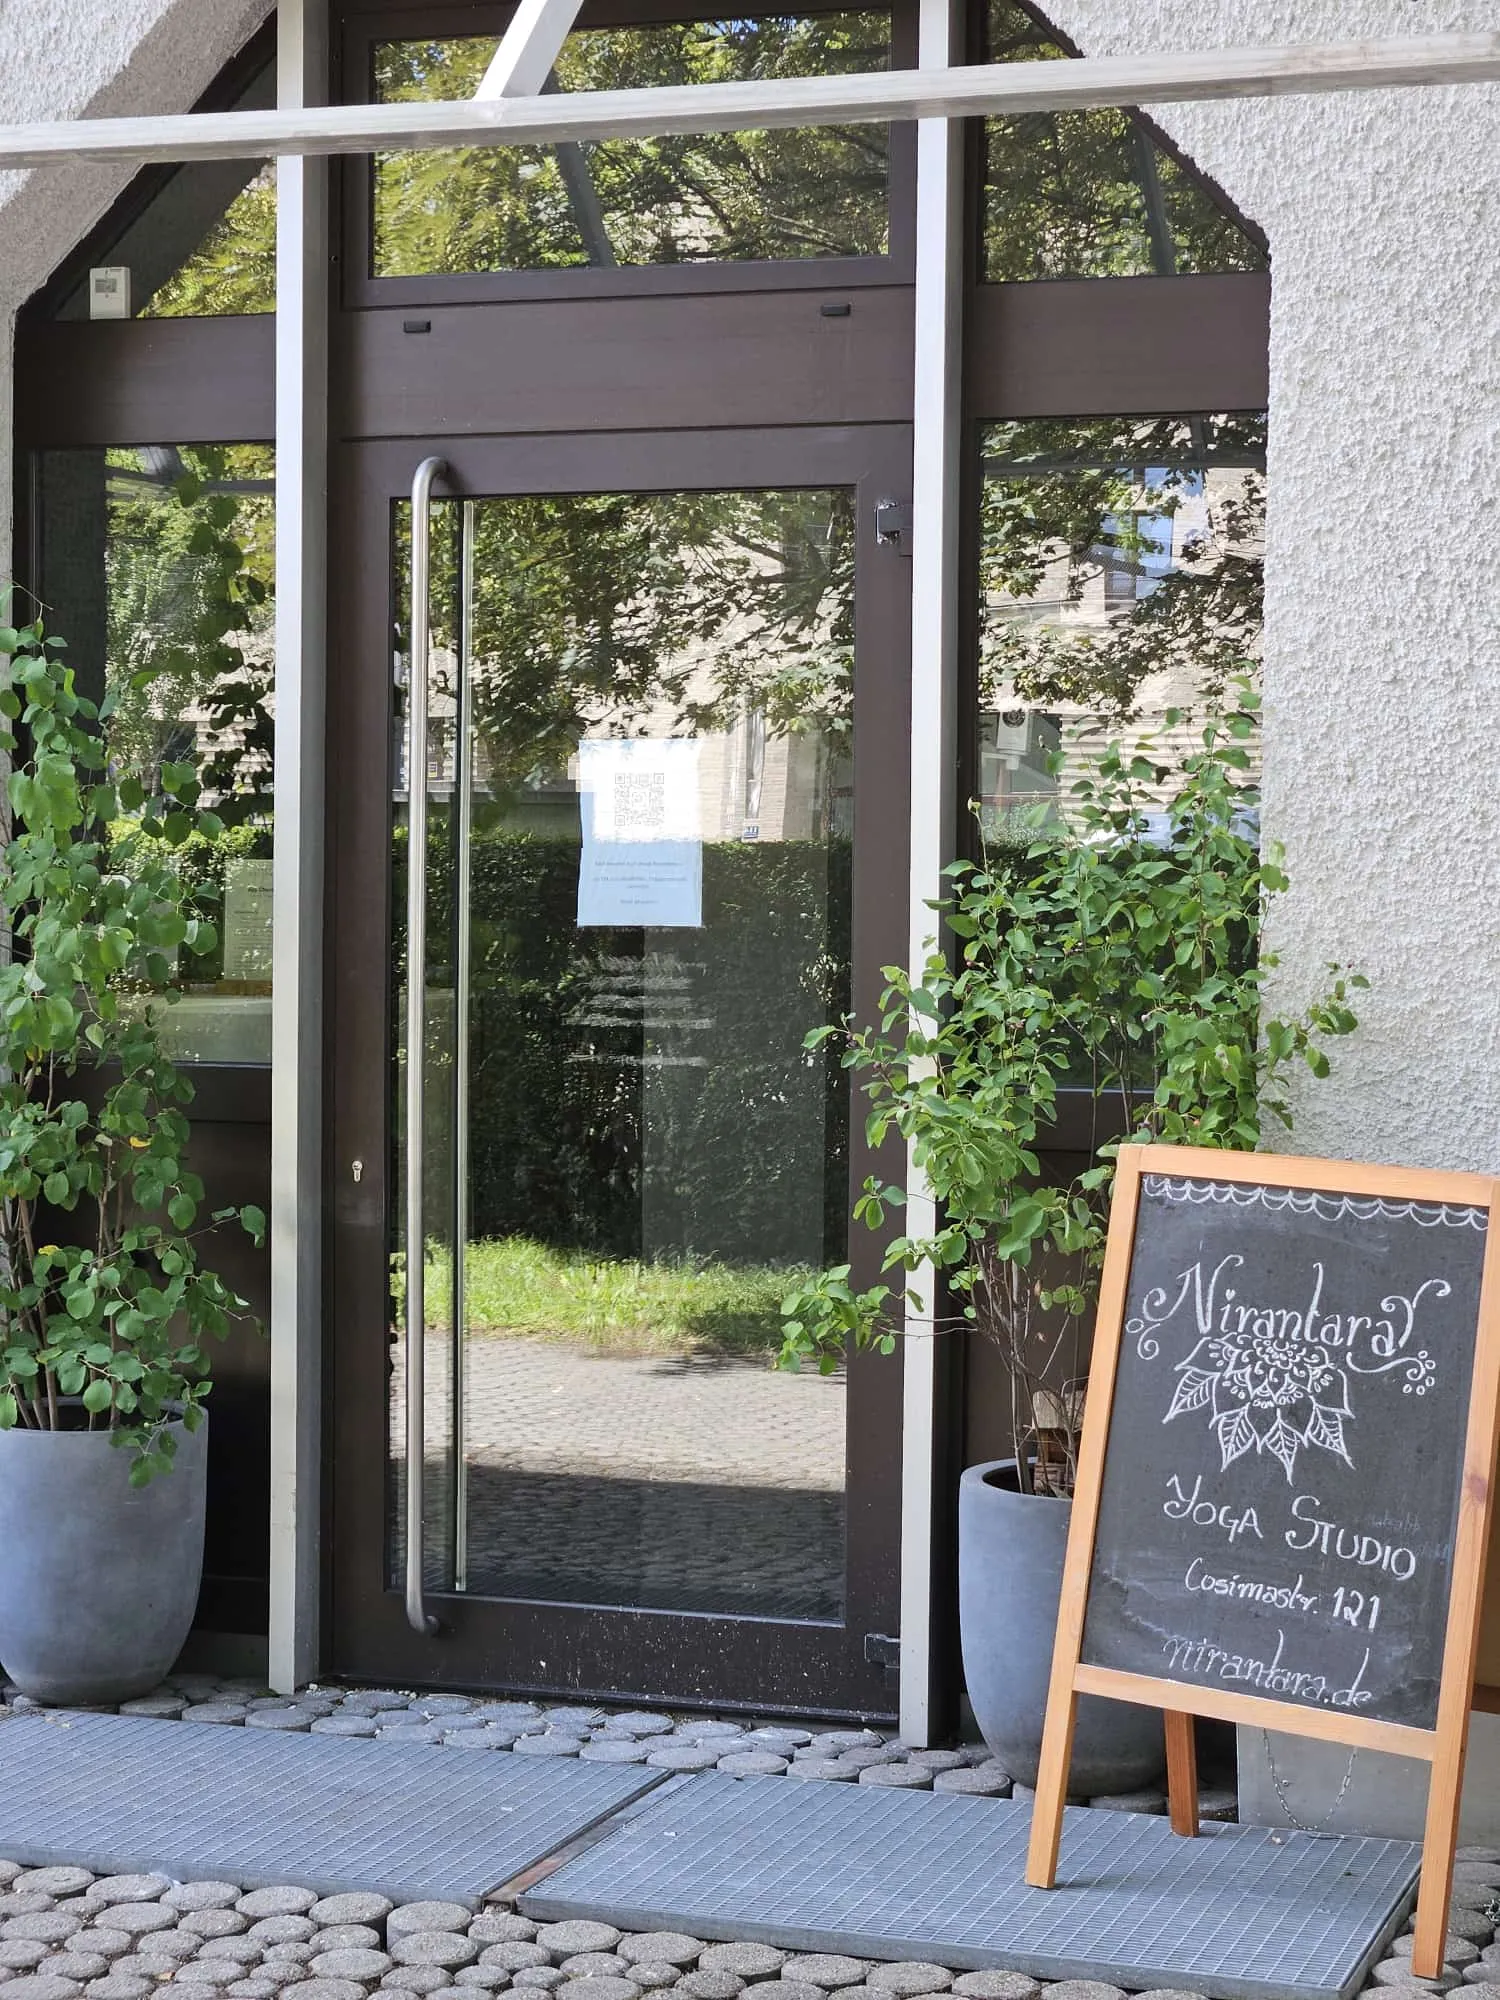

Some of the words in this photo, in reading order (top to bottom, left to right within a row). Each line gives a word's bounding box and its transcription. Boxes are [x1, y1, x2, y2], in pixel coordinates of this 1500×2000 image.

[1143, 1254, 1413, 1357] Nirantara
[1163, 1473, 1264, 1543] YOGA
[1285, 1495, 1416, 1581] STUDIO
[1184, 1557, 1319, 1615] Cosimastr.
[1332, 1586, 1380, 1633] 121
[1162, 1629, 1373, 1708] nirantara.de
